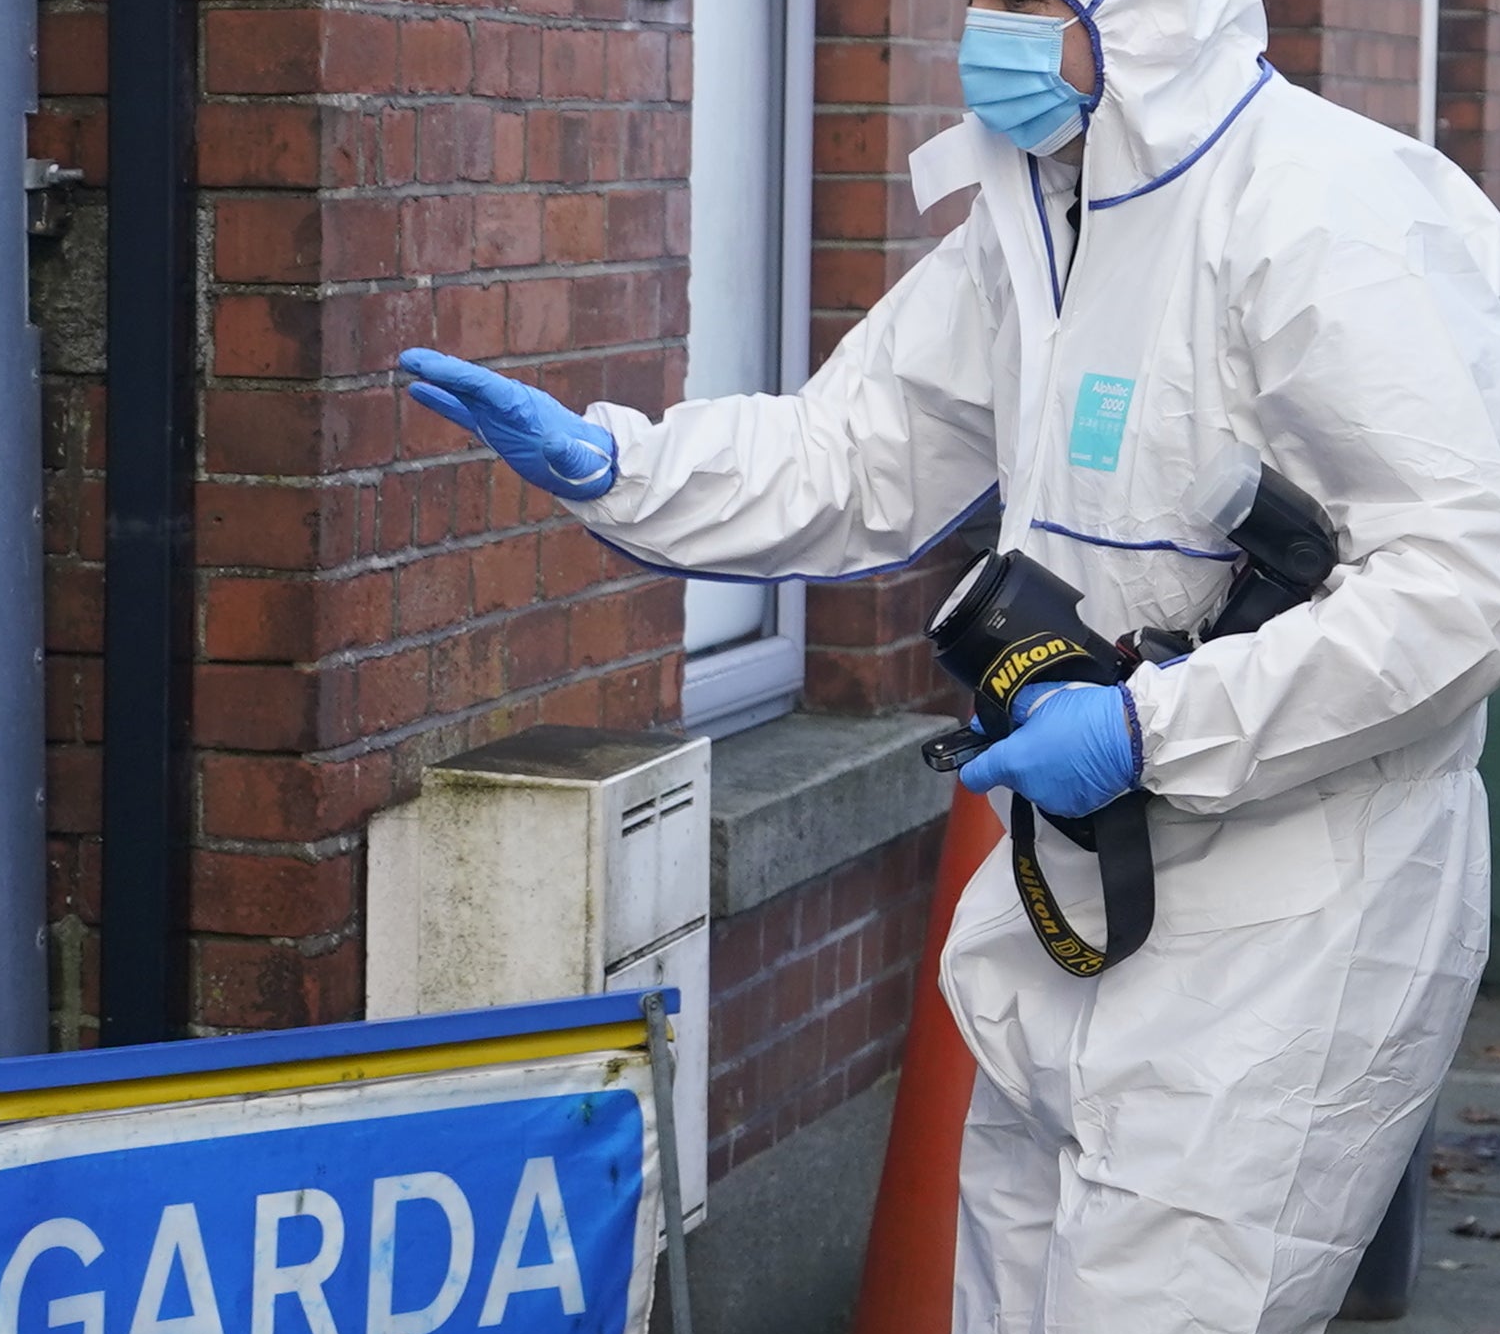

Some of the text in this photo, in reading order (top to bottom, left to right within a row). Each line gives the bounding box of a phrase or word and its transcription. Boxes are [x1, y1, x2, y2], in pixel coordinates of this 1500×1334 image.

[1101, 397, 1126, 412] 2000
[990, 638, 1067, 699] Nikon
[1018, 855, 1060, 934] Nikon
